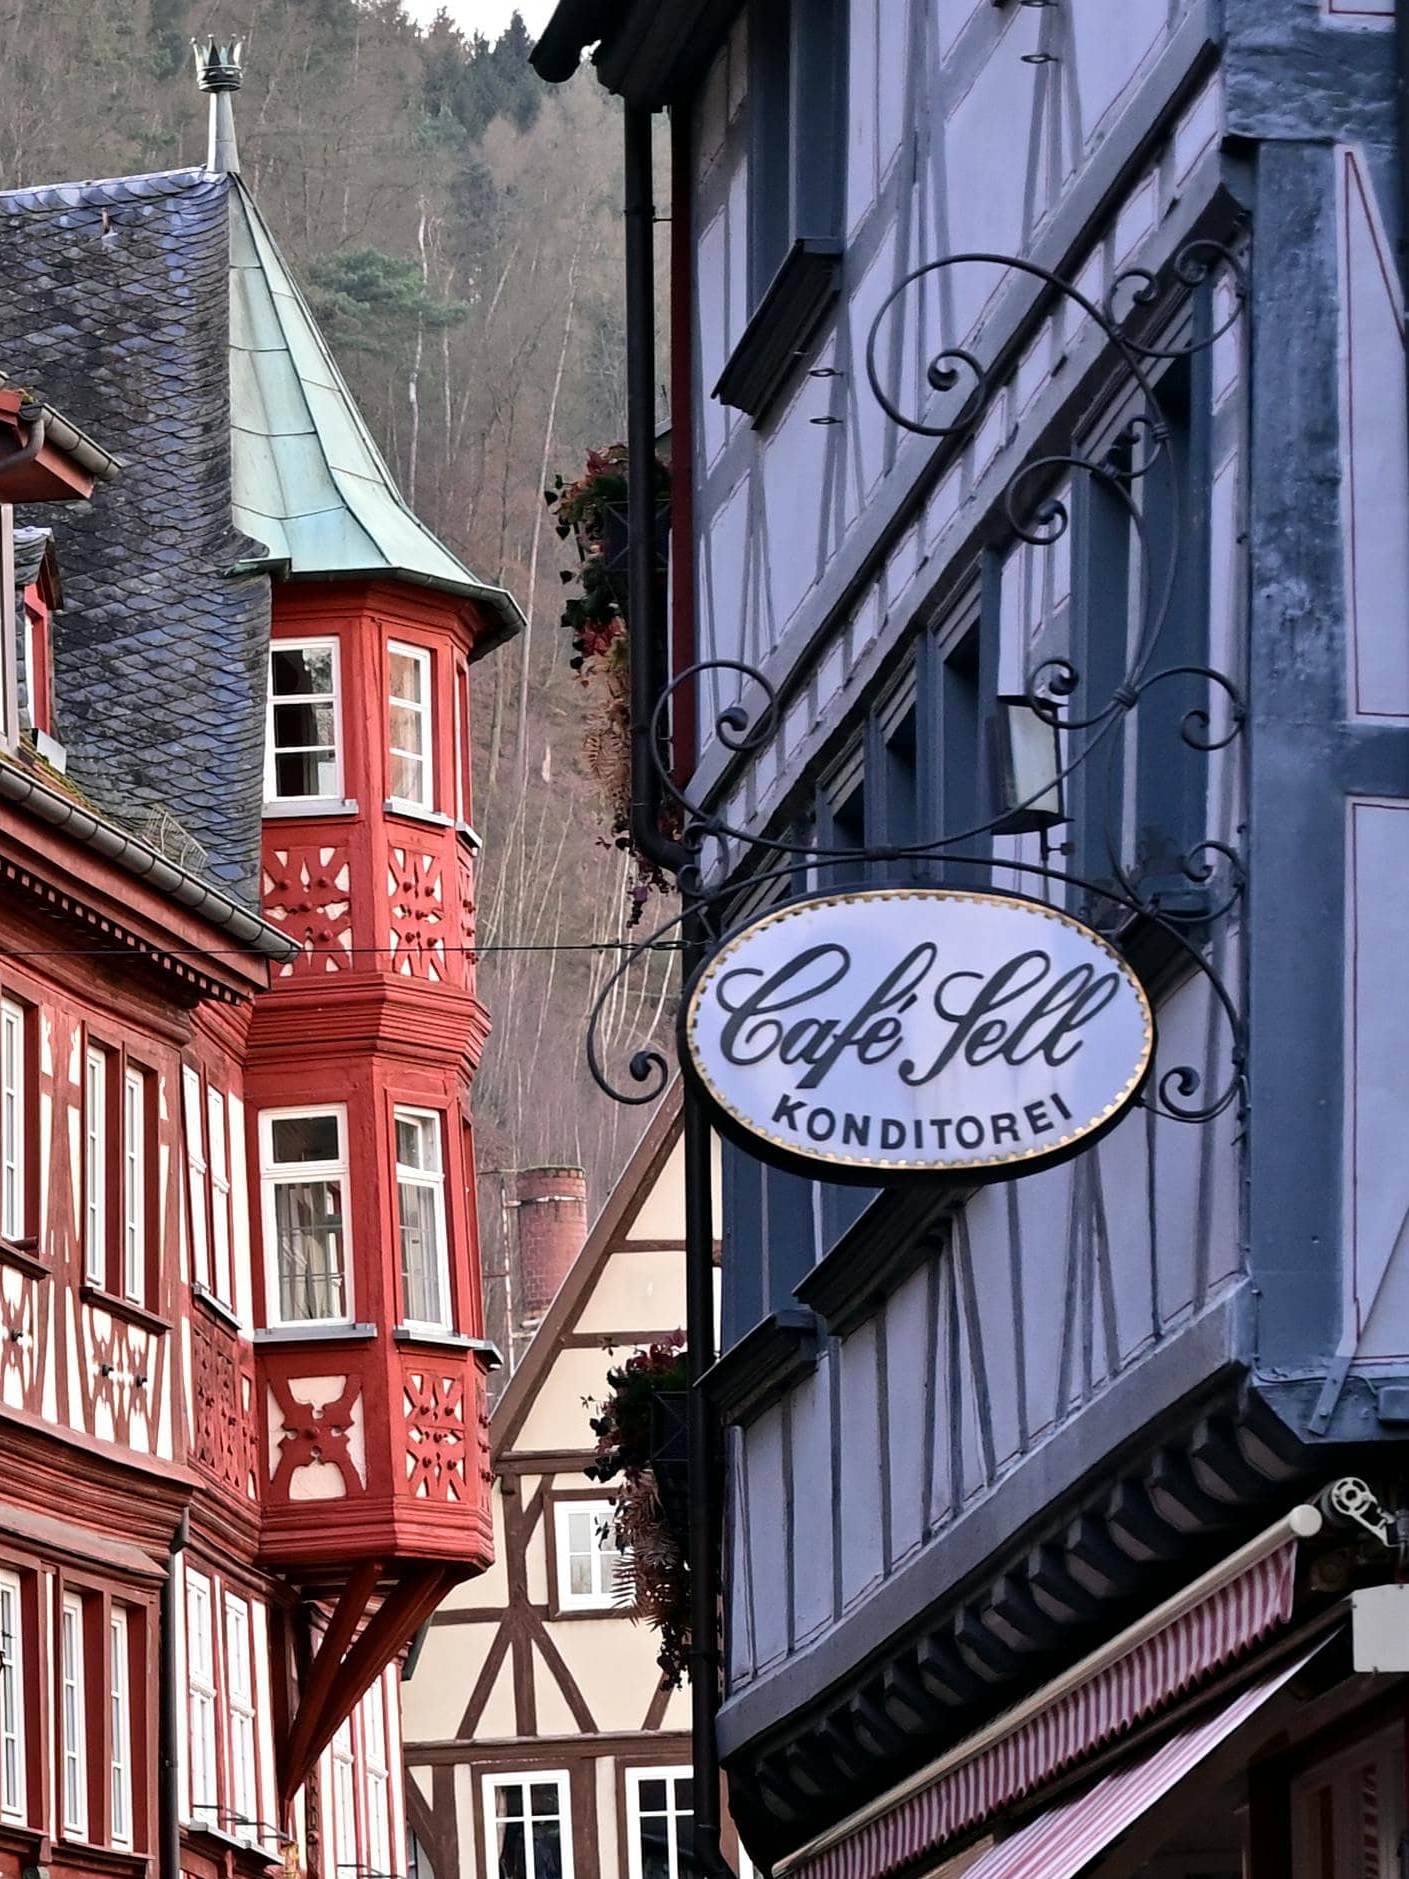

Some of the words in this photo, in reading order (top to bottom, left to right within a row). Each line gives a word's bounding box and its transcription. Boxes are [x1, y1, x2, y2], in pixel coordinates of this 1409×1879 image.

[716, 941, 938, 1090] Café
[898, 949, 1121, 1087] Sell
[771, 1093, 1074, 1151] KONDITOREI
